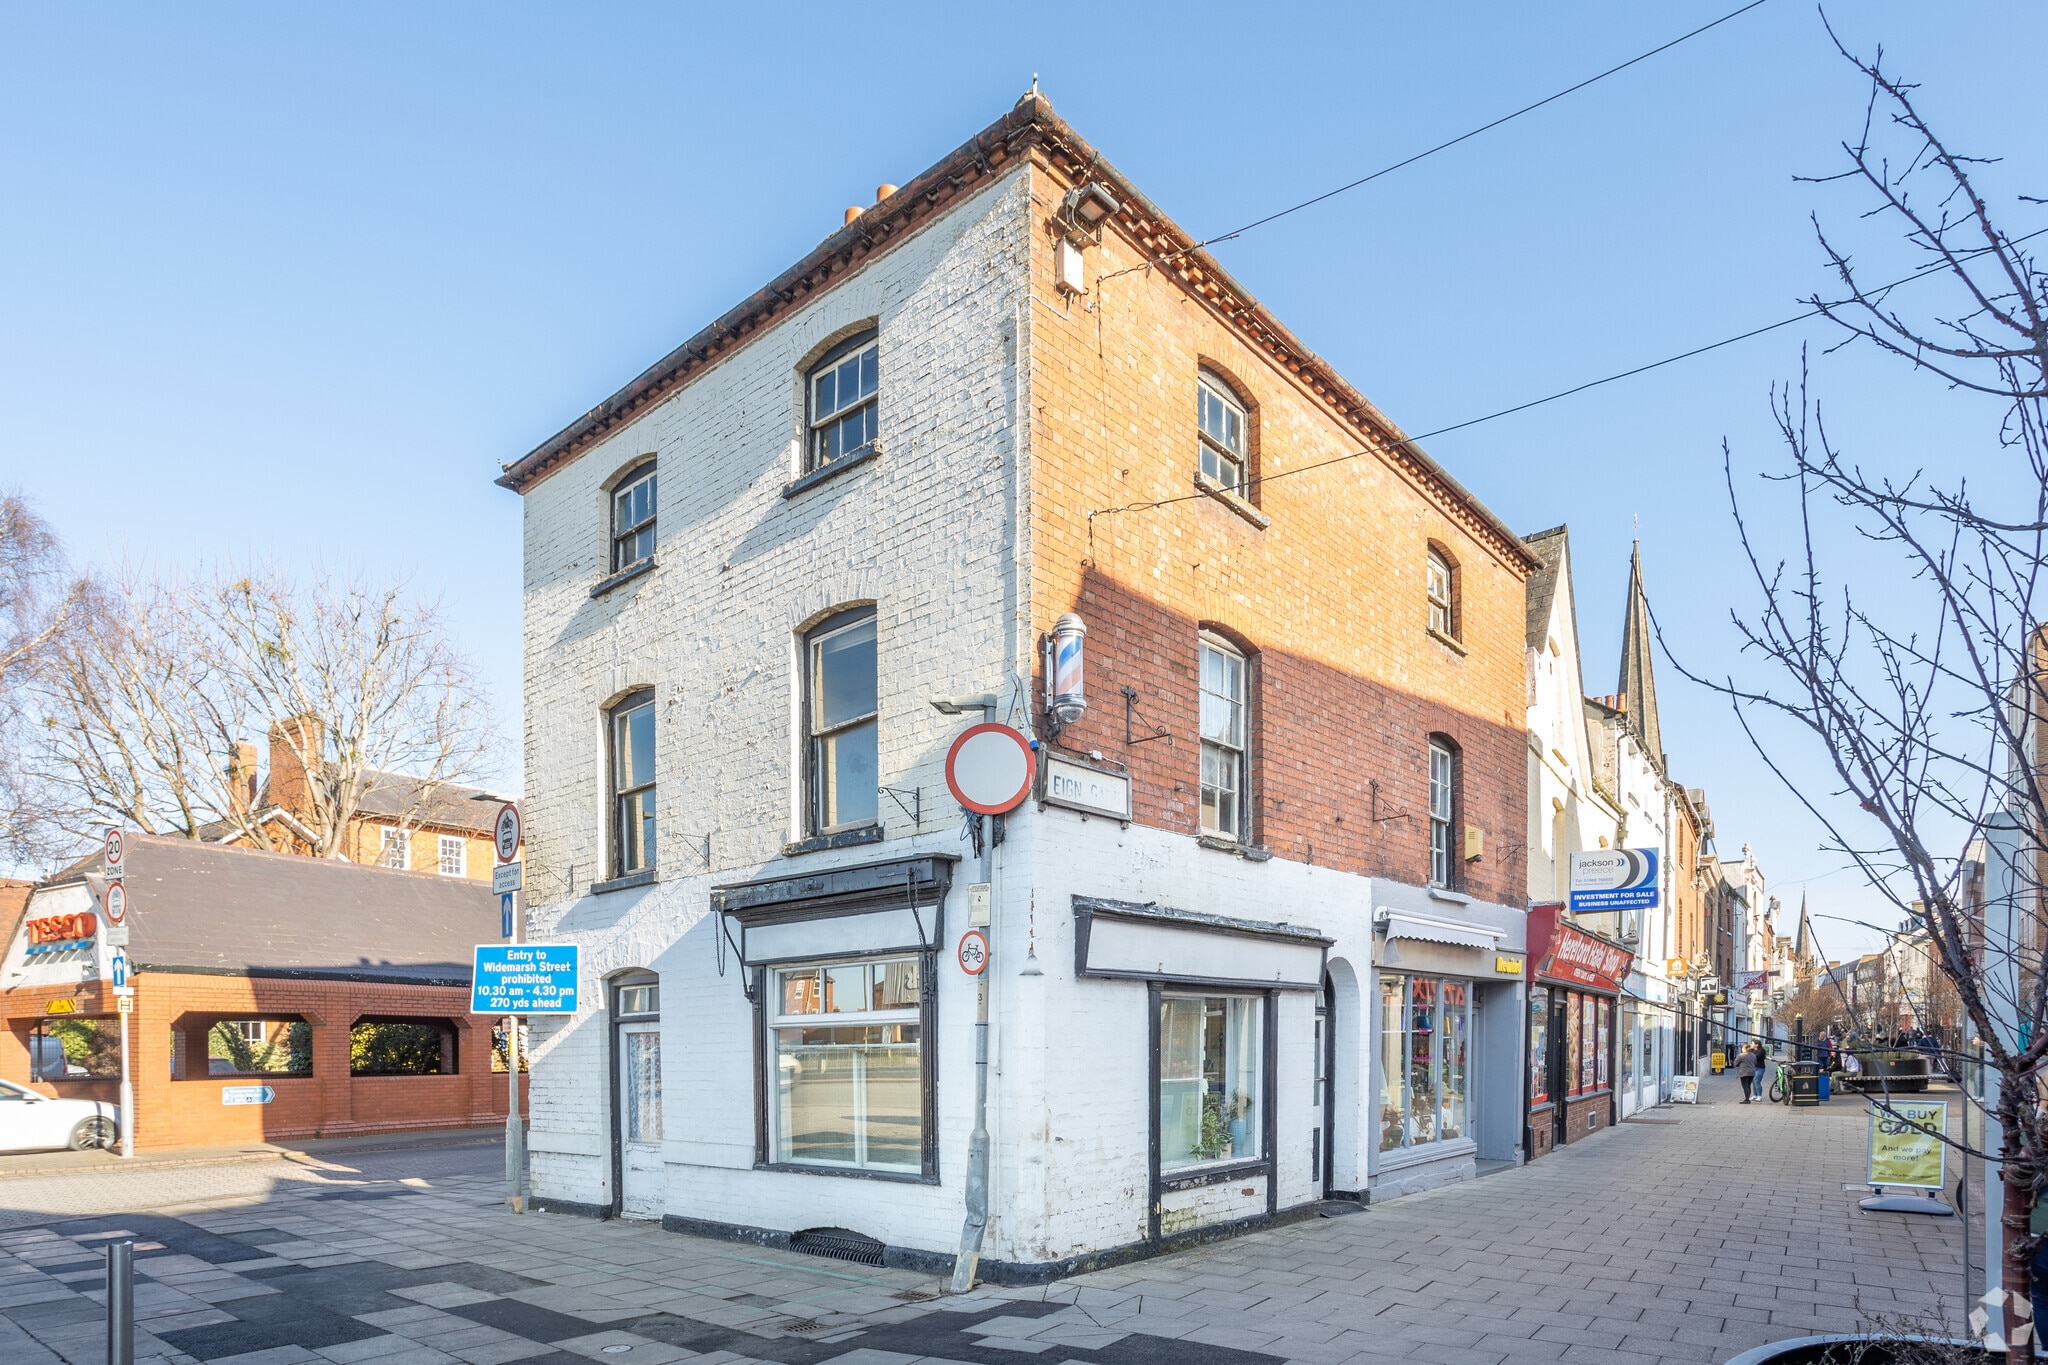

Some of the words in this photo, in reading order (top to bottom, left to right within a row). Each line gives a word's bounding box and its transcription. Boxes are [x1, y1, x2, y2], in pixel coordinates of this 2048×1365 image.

[1053, 775, 1082, 797] EIGN
[108, 840, 120, 855] 20
[1579, 860, 1613, 869] jackson
[106, 865, 122, 876] ZONE
[495, 869, 511, 880] Except
[511, 867, 520, 876] for
[1582, 867, 1614, 875] preece
[499, 878, 516, 889] access
[1574, 892, 1619, 900] INVESTMENT
[26, 912, 97, 944] TESCO
[507, 950, 533, 961] Entry
[536, 950, 547, 960] to
[1557, 931, 1593, 965] Hereford
[1602, 947, 1620, 977] Shop
[483, 962, 536, 972] Widemarsh
[539, 962, 571, 971] Street
[501, 974, 552, 985] prohibited
[477, 986, 506, 995] 10.30
[533, 986, 556, 995] 4.30
[559, 988, 574, 997] pm
[490, 998, 510, 1008] 270
[513, 998, 529, 1009] yds
[532, 998, 562, 1008] ahead
[1907, 1109, 1938, 1120] BUY
[1915, 1147, 1932, 1155] pay
